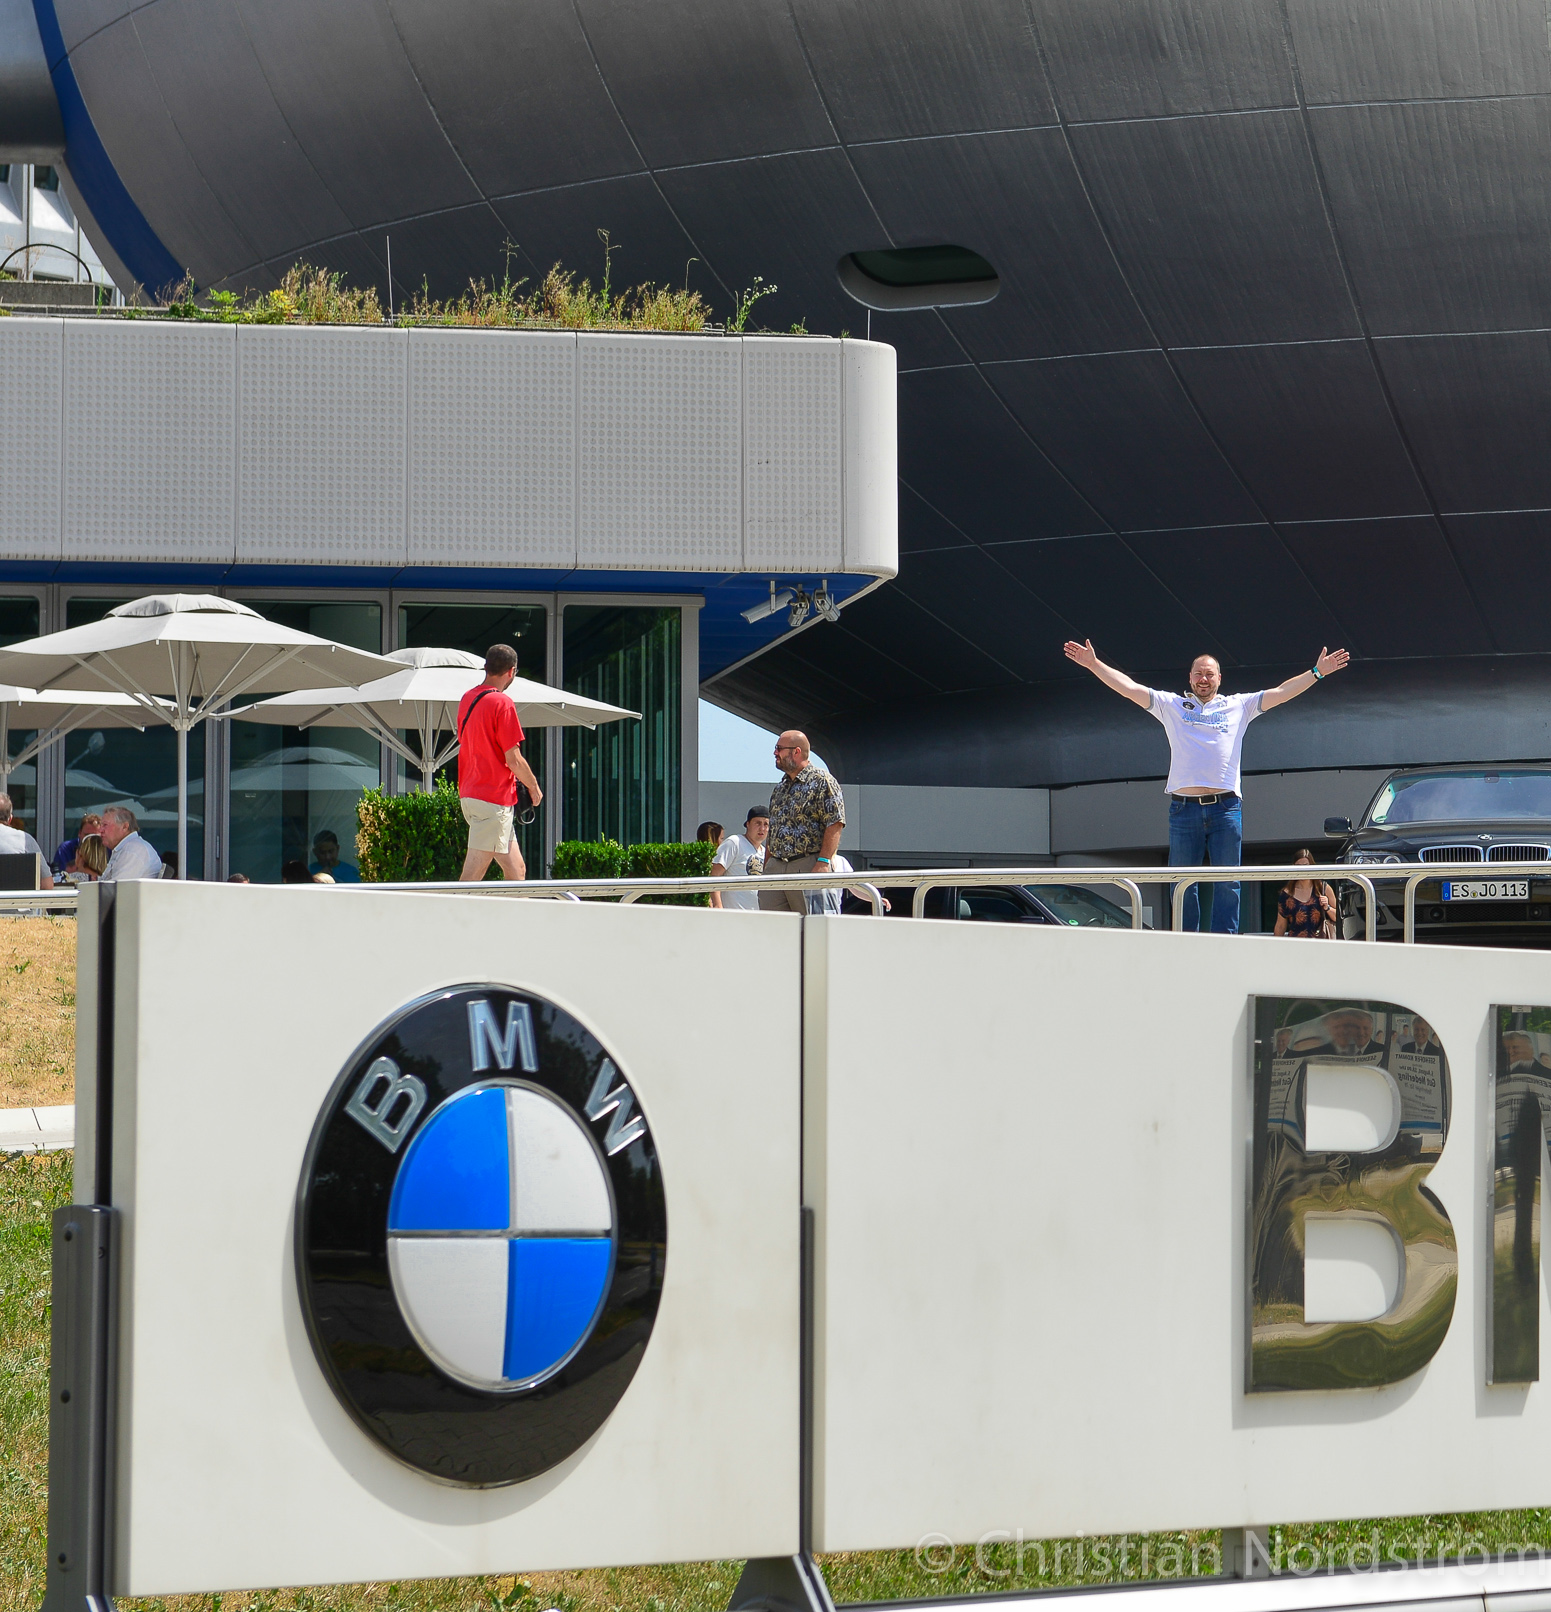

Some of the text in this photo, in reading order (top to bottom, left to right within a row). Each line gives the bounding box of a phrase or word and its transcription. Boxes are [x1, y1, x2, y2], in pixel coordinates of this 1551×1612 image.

[1452, 884, 1469, 897] ES
[1479, 884, 1497, 896] JO
[1501, 883, 1527, 896] 113
[344, 999, 645, 1156] BMW
